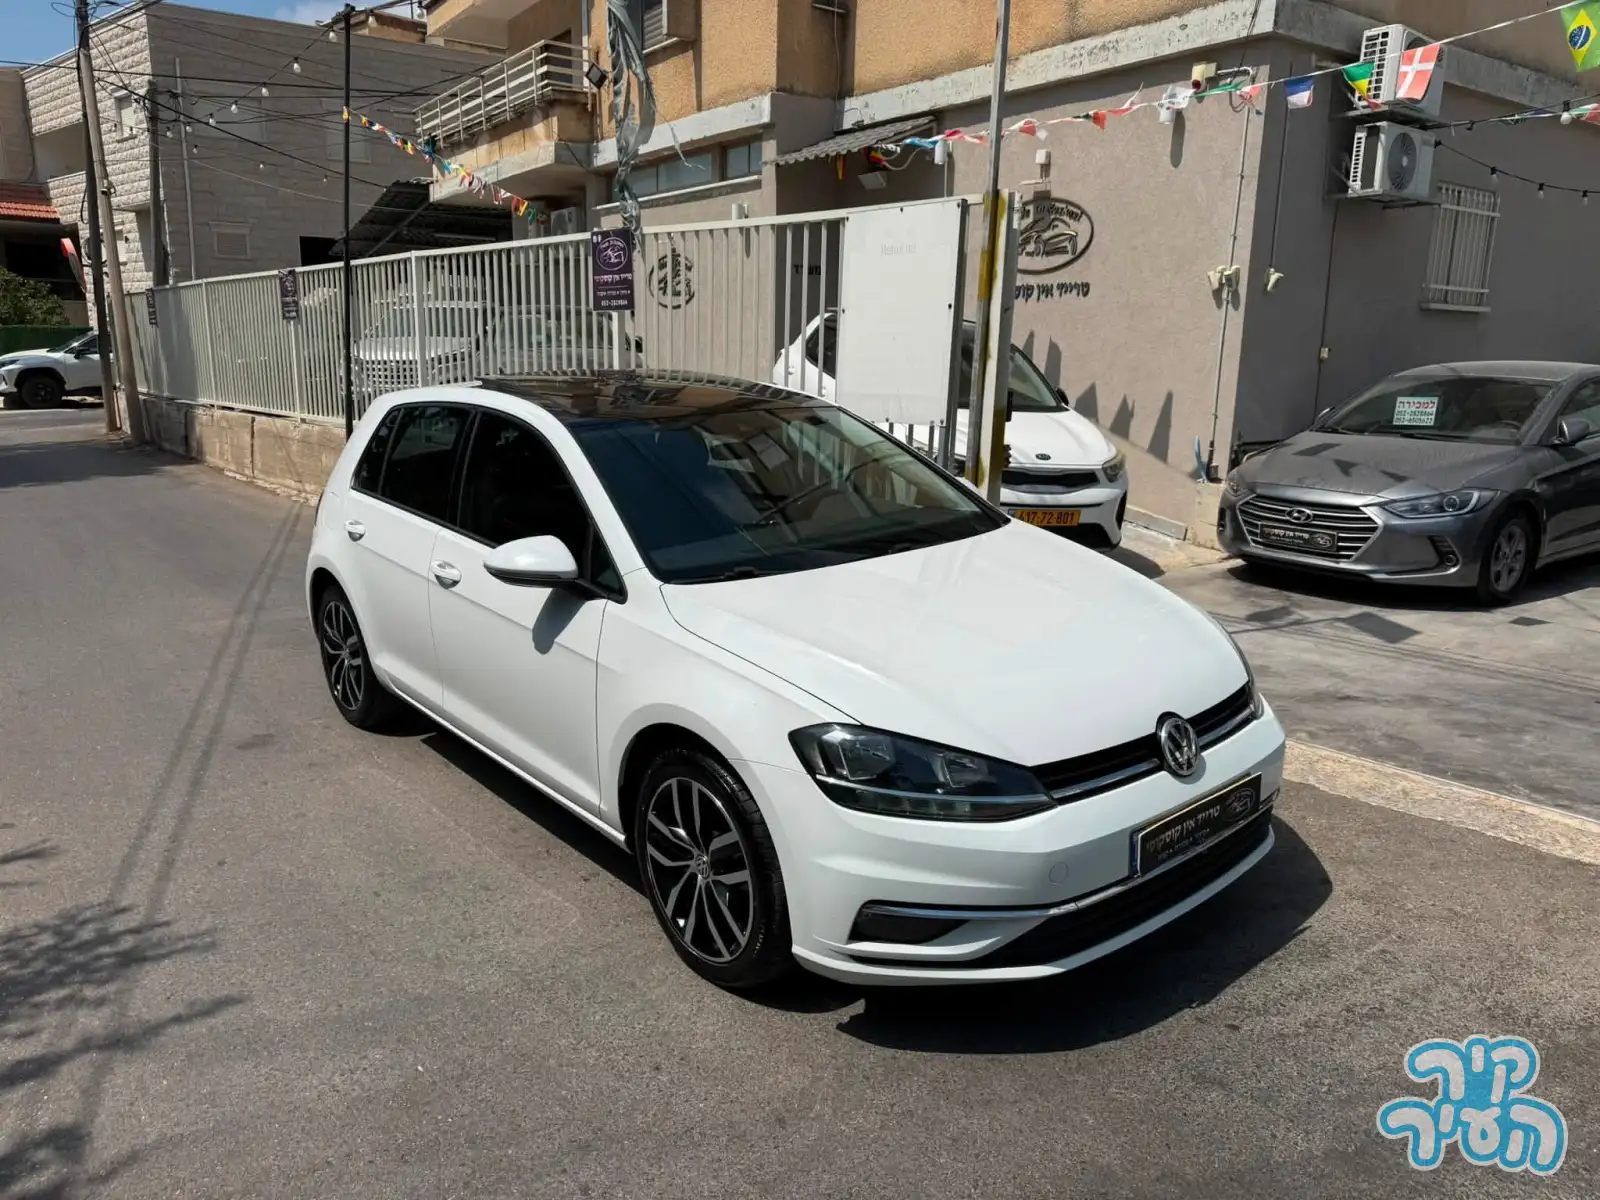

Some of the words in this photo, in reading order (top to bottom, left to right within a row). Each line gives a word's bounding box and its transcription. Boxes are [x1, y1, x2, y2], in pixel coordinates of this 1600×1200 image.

[1036, 282, 1054, 302] אין
[1056, 281, 1090, 298] טרייד
[1398, 400, 1436, 409] למכירה
[1198, 805, 1221, 825] טרייד
[1182, 817, 1196, 835] אין
